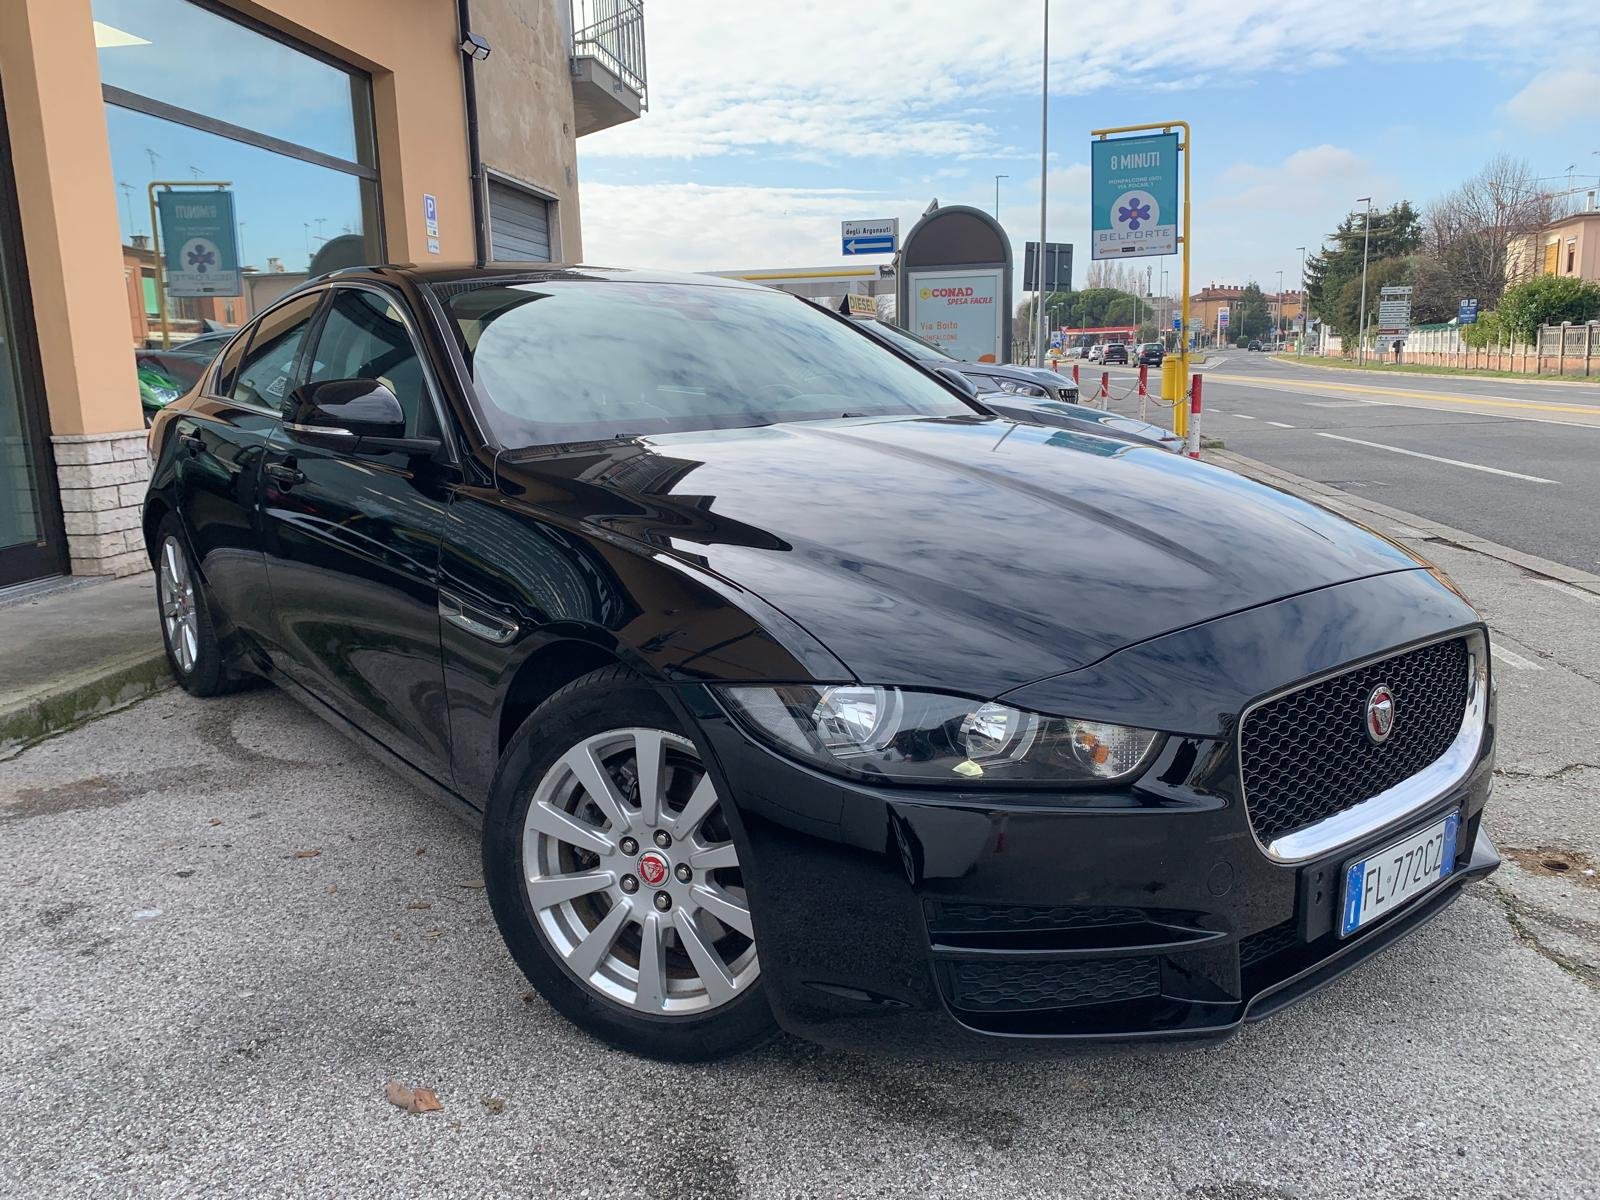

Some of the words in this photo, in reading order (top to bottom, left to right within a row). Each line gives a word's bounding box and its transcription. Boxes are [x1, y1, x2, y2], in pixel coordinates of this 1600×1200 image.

[1110, 155, 1118, 170] 8
[1120, 151, 1160, 170] MINUTI
[427, 199, 434, 218] P
[846, 227, 861, 236] degli
[862, 226, 892, 235] Argonauti
[1100, 229, 1170, 242] BELFORTE
[931, 287, 973, 298] CONAD
[849, 296, 876, 312] DIESEL
[946, 298, 968, 306] SPESA
[969, 296, 993, 305] FACILE
[920, 321, 933, 331] Via
[936, 320, 959, 330] Boito
[1363, 866, 1385, 911] FL
[1391, 833, 1443, 897] 772CZ
